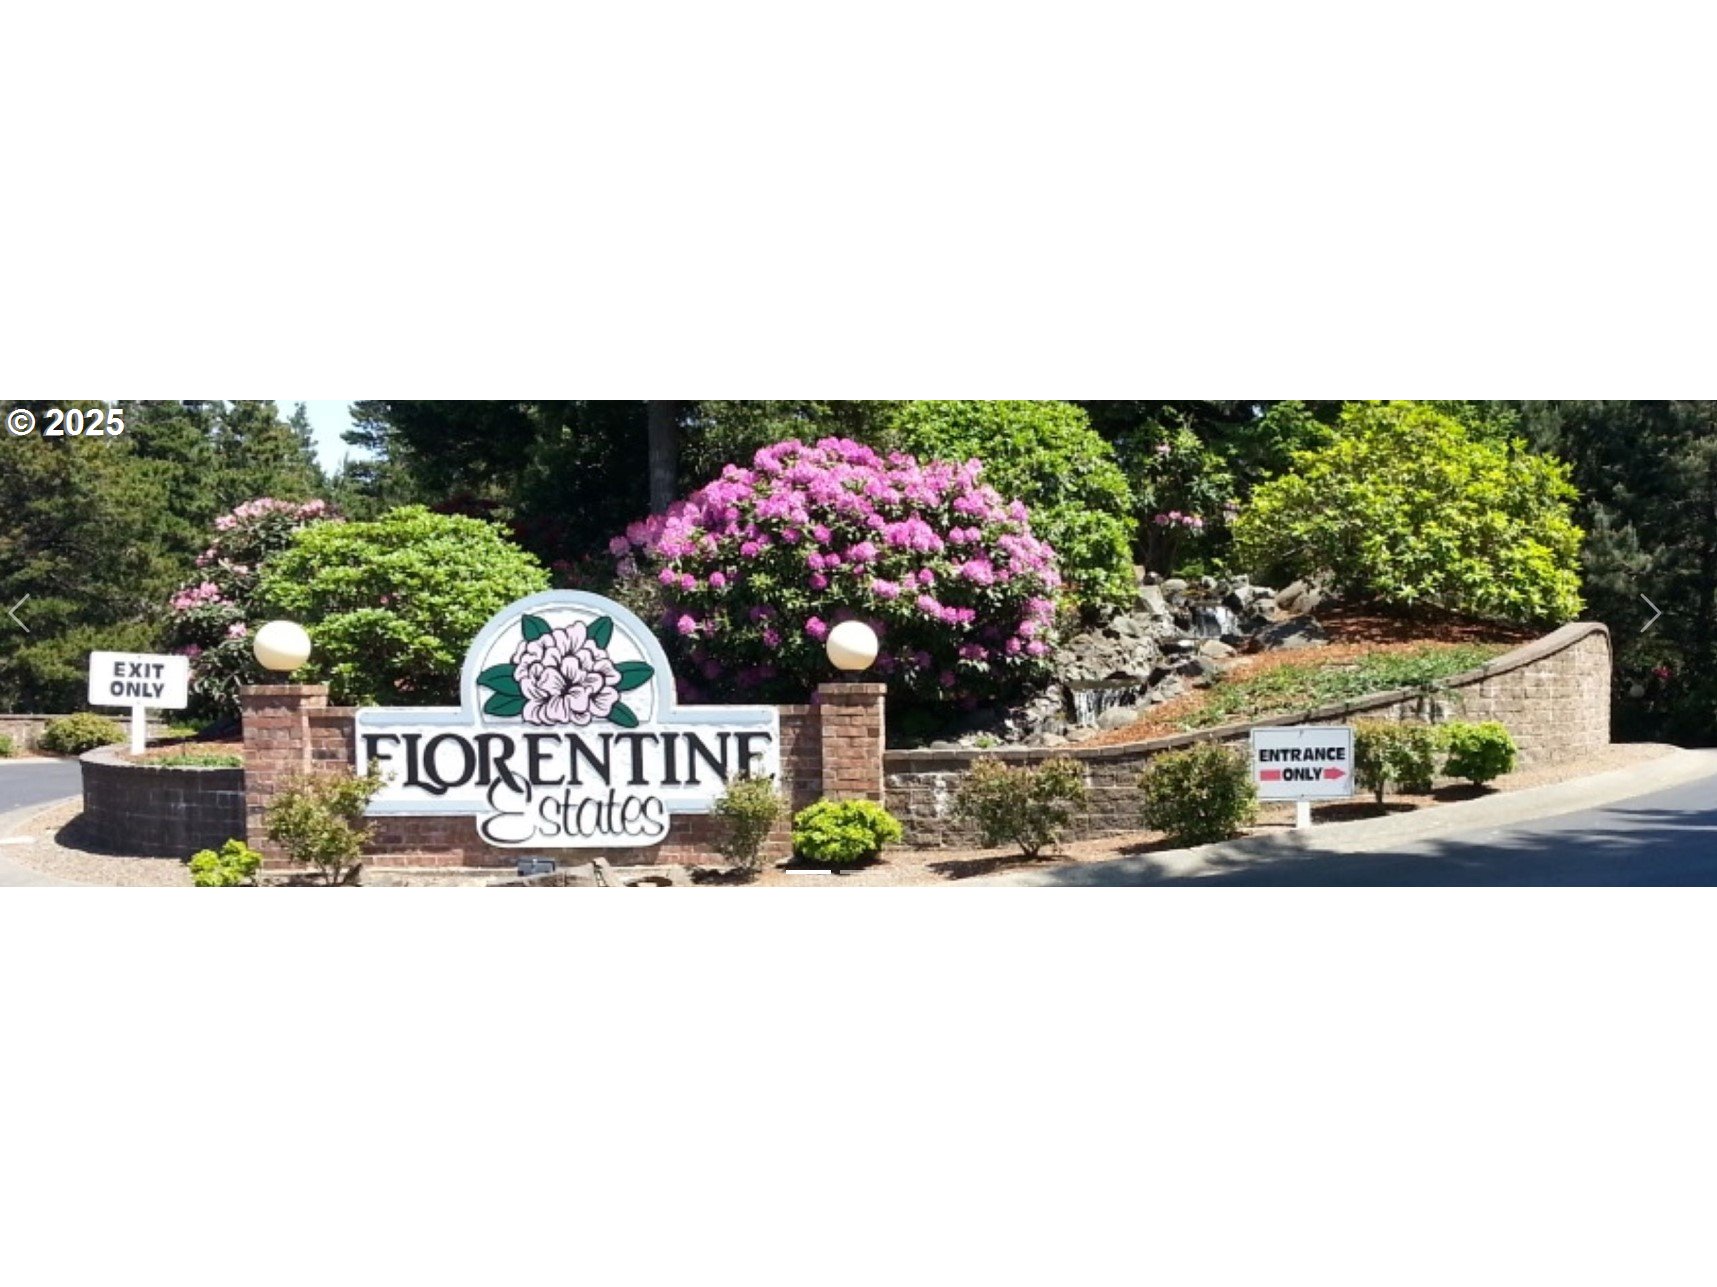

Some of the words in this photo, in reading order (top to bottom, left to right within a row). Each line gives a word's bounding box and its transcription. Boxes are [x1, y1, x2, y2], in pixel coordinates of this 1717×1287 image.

[114, 661, 165, 679] EXIT
[110, 680, 165, 698] ONLY
[1258, 747, 1346, 762] ENTRANCE
[1282, 767, 1323, 781] ONLY
[481, 771, 664, 844] Estates
